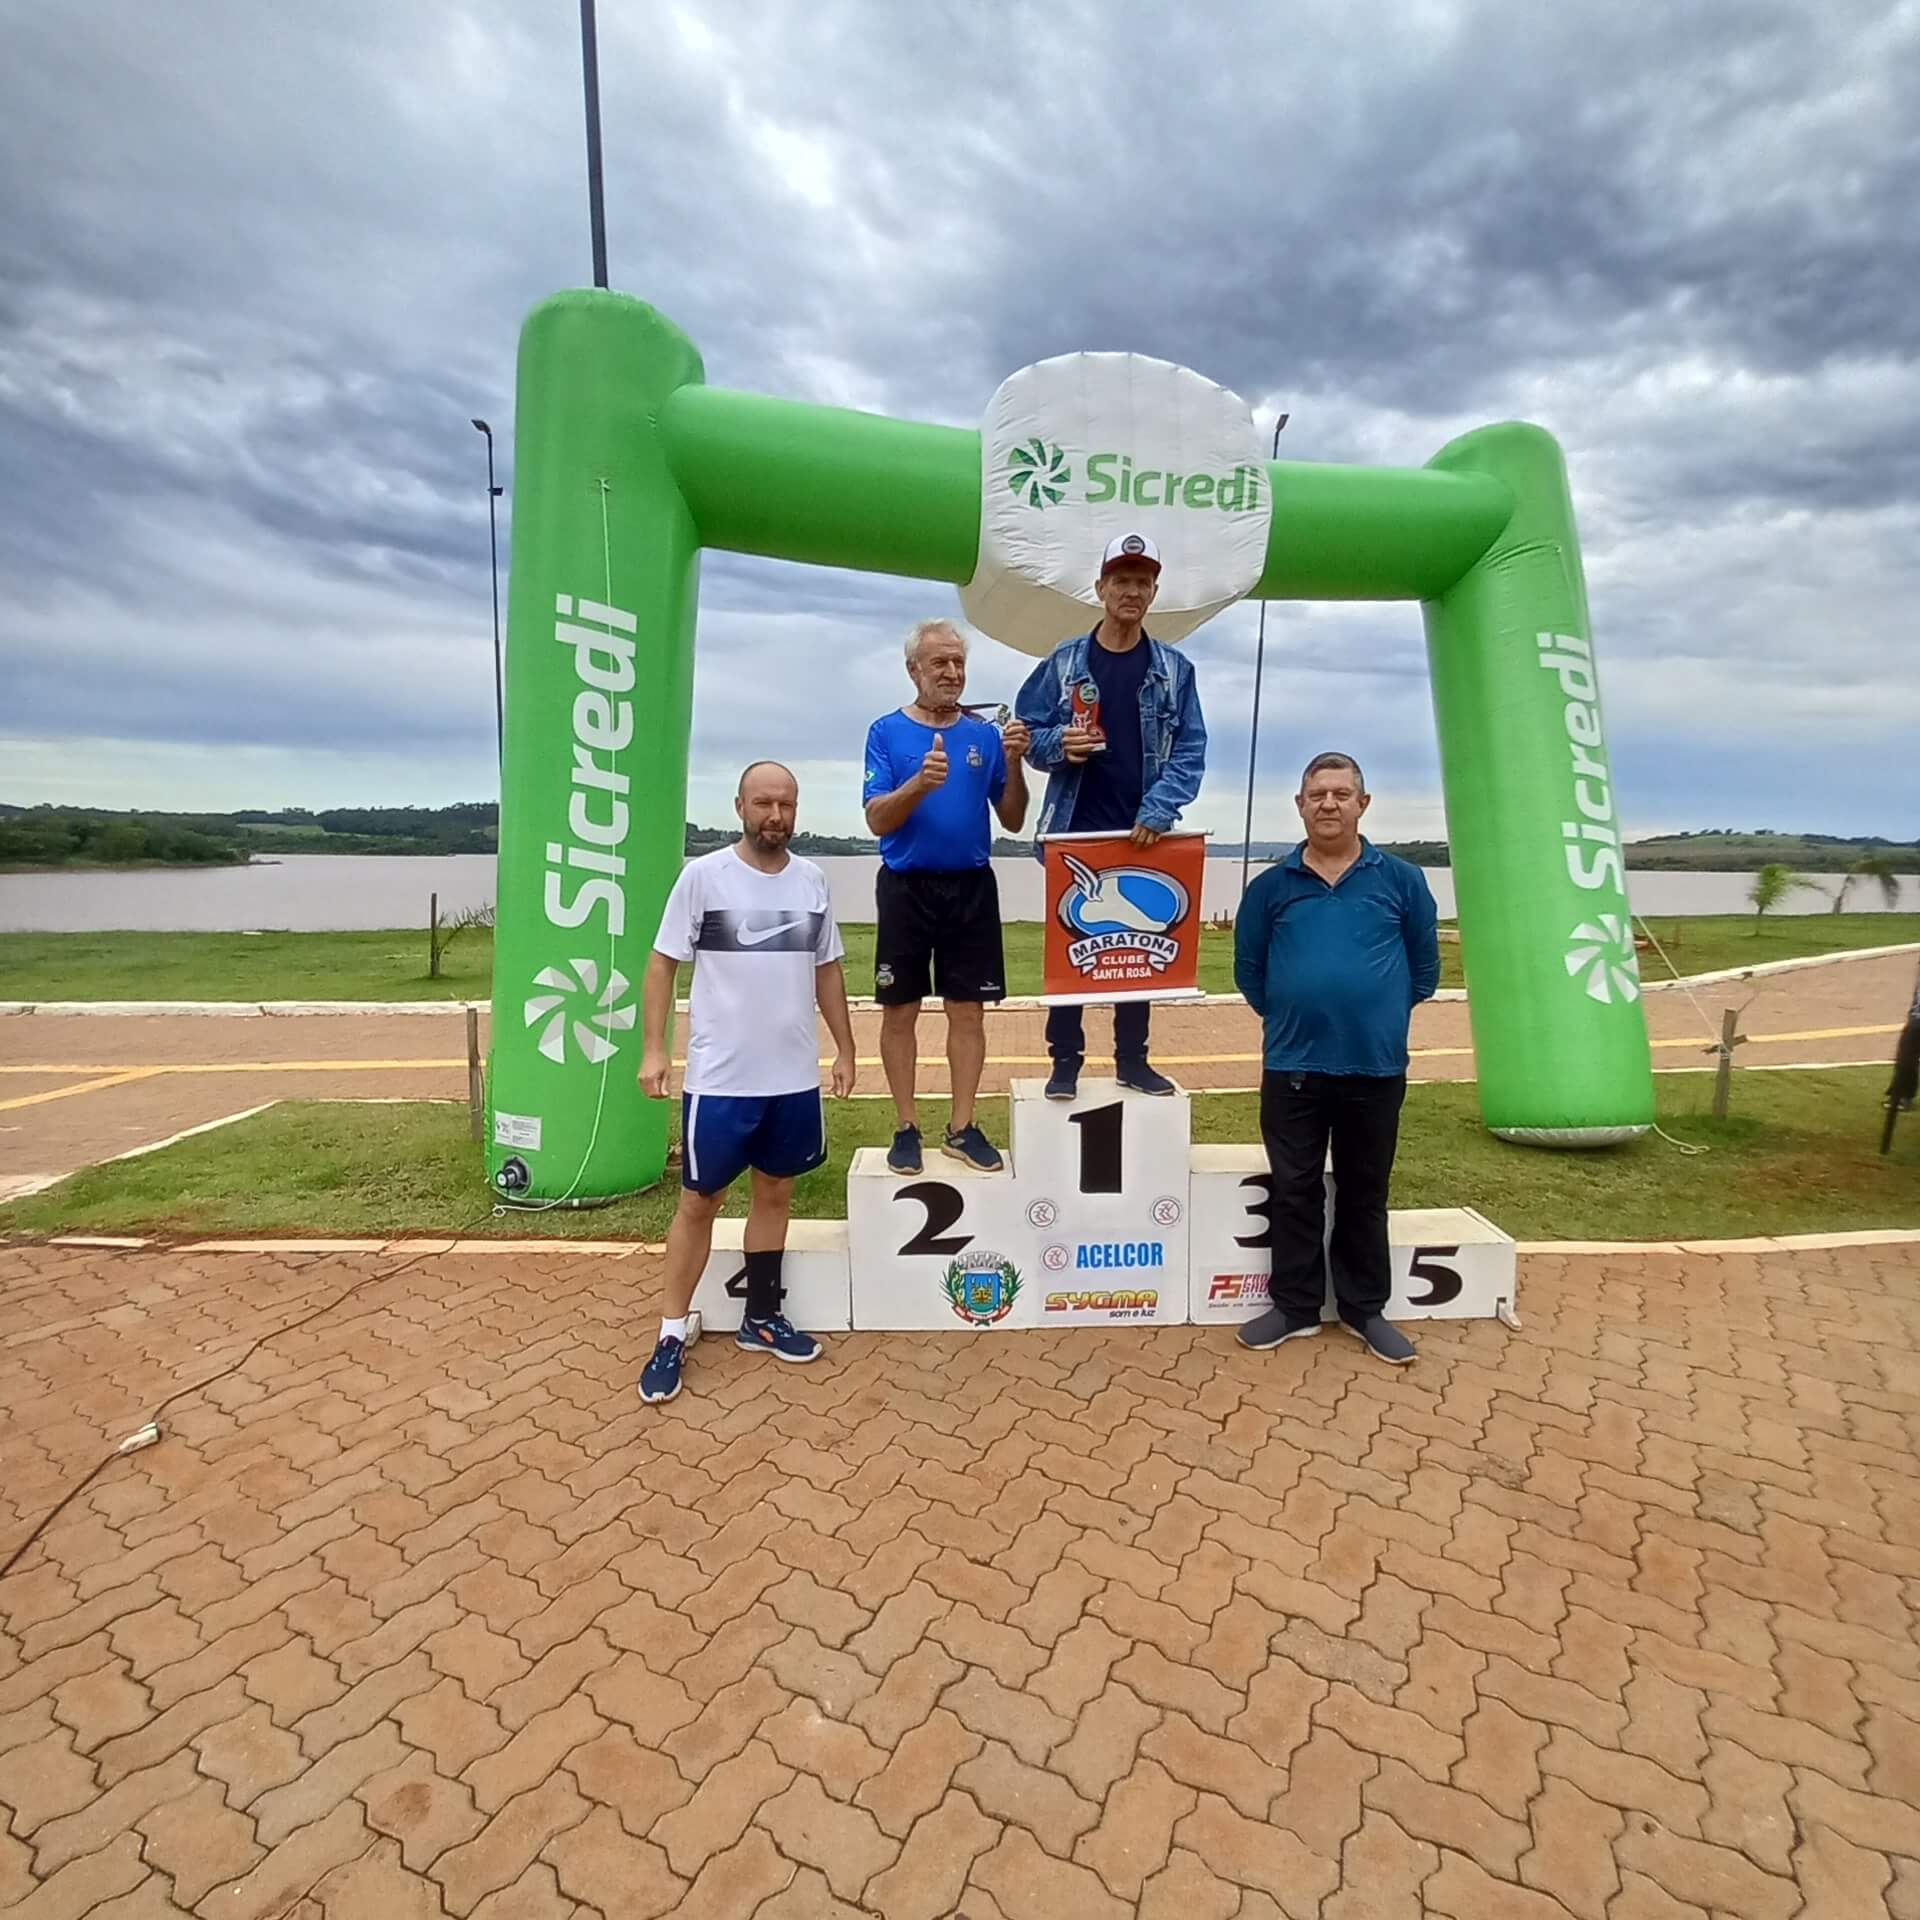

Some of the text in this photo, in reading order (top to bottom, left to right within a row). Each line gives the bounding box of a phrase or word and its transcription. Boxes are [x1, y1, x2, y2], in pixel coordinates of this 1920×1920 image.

[1085, 454, 1259, 512] Sicredi
[544, 593, 637, 937] Sicredi
[1536, 632, 1624, 895] Sicredi
[1072, 933, 1176, 959] MARATONA
[1101, 955, 1145, 965] CLUBE
[1092, 967, 1151, 980] SANTA ROSA
[1068, 1101, 1124, 1194] 1
[893, 1181, 975, 1256] 2
[1076, 1243, 1163, 1269] ACELCOR
[1406, 1246, 1463, 1306] 5
[1045, 1290, 1158, 1311] SYGMA
[1109, 1308, 1156, 1318] som e luz
